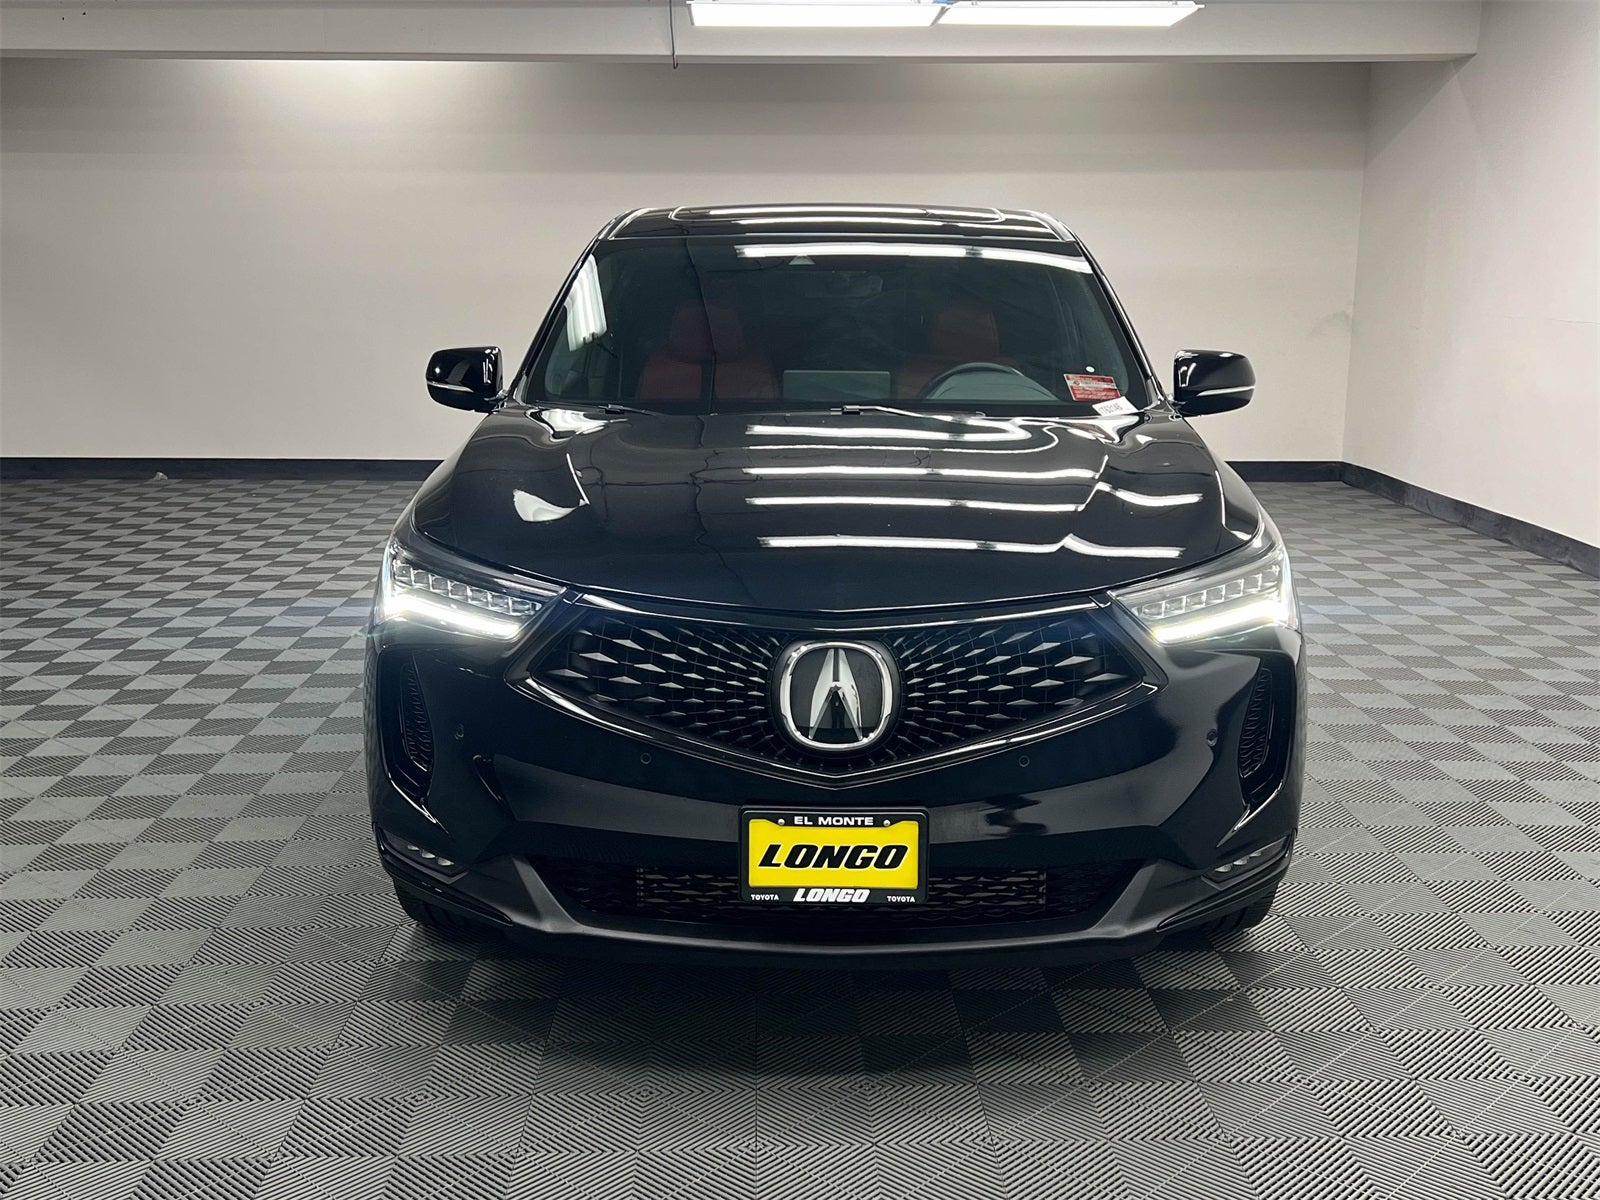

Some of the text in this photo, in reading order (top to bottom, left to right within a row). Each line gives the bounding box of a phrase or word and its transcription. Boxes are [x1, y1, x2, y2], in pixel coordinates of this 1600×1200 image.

[793, 816, 874, 826] EL MONTE
[758, 844, 909, 869] LONGO
[750, 893, 779, 901] TOYOTA
[793, 888, 871, 903] LONGO
[886, 895, 916, 903] TOYOTA
